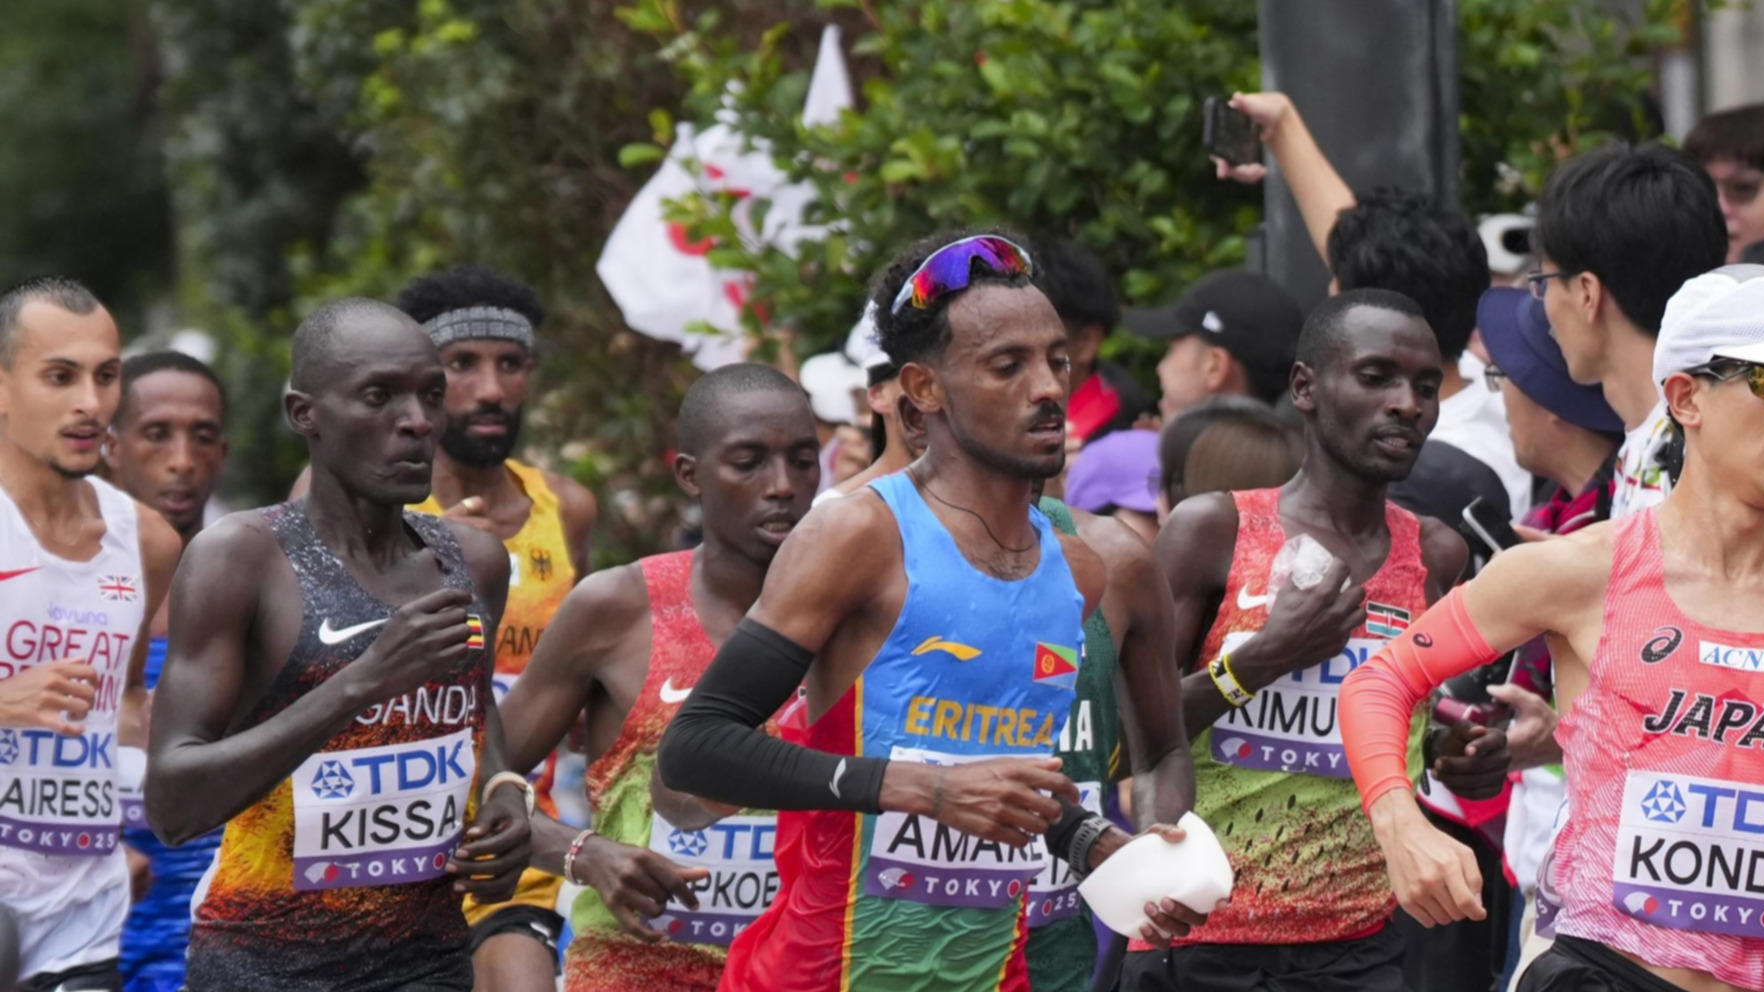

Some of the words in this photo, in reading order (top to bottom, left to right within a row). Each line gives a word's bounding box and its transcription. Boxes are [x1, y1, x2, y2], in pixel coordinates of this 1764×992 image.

[6, 619, 130, 671] GREAT
[1703, 646, 1764, 669] ACN
[904, 695, 1054, 747] ERITREA
[21, 730, 112, 768] TDK
[352, 739, 467, 795] TDK
[320, 794, 456, 850] KISSA
